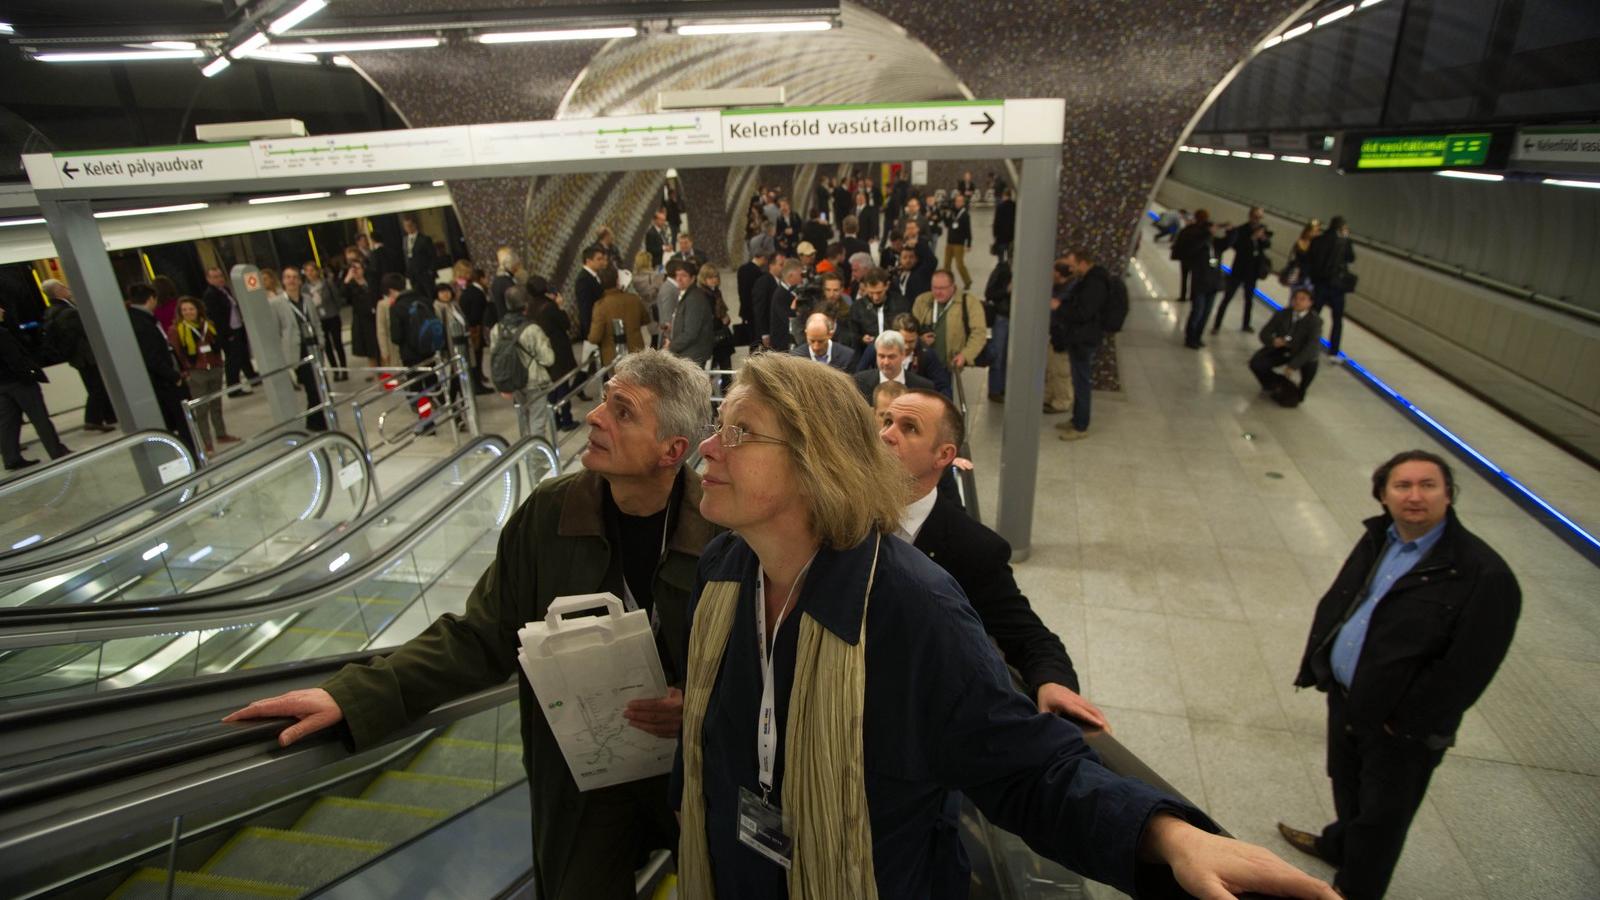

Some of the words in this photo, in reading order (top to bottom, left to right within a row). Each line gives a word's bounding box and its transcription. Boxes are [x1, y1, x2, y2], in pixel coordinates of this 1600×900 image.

[730, 118, 820, 138] Kelenföld
[828, 114, 959, 134] vasútállomás
[83, 160, 124, 177] Keleti
[128, 157, 204, 177] pályaudvar
